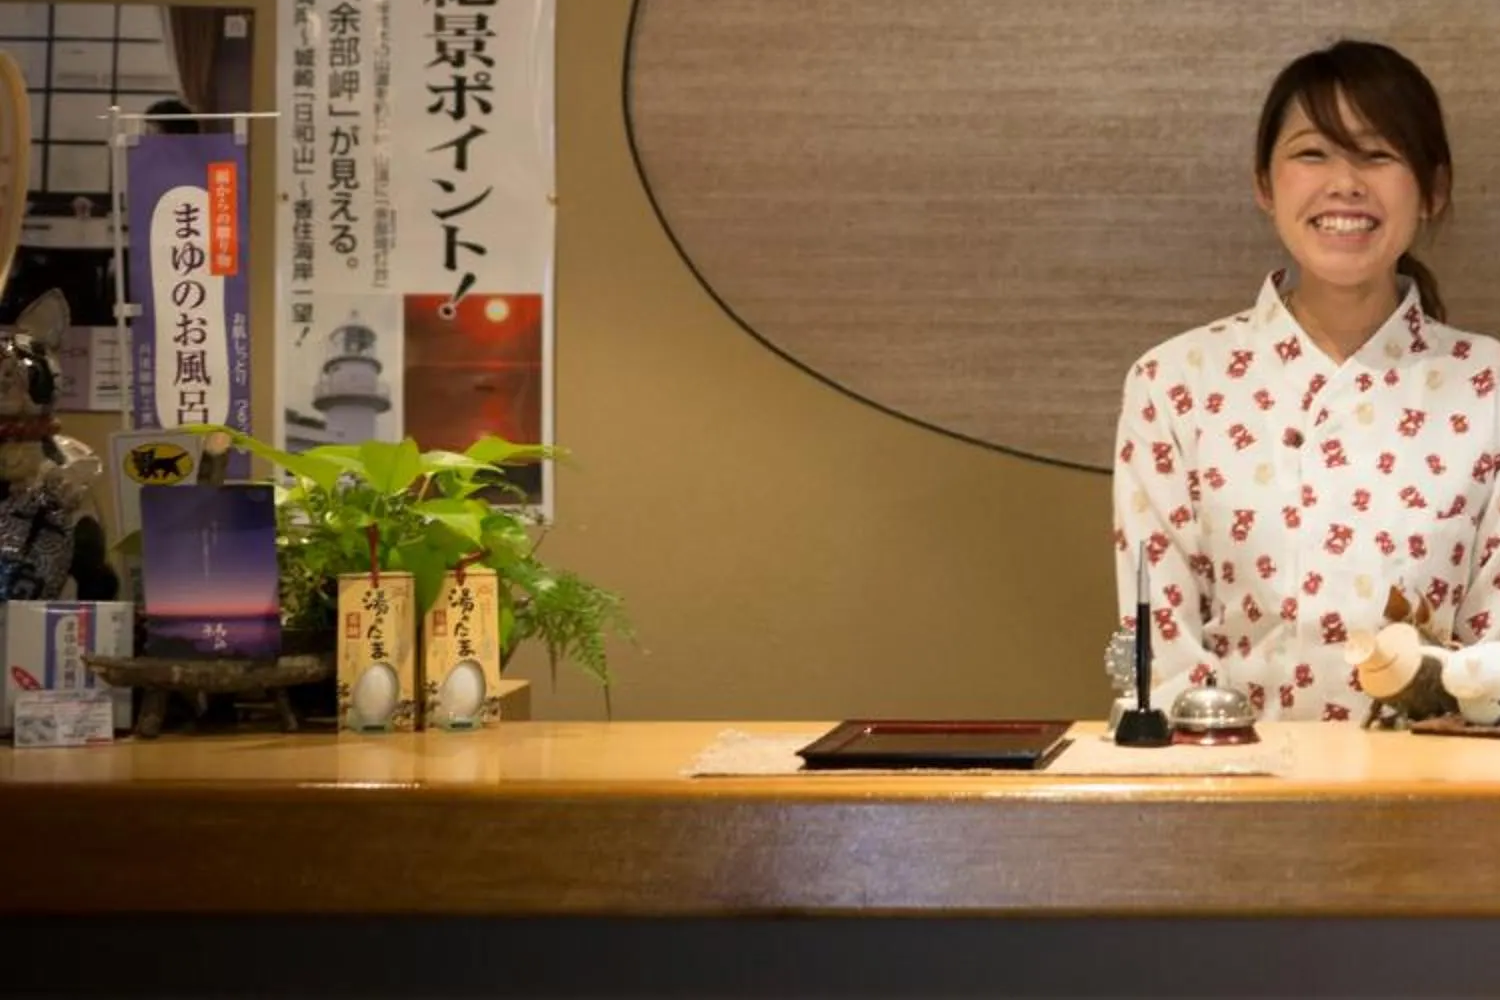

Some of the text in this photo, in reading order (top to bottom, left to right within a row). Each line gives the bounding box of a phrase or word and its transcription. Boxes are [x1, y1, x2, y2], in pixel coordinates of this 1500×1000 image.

[171, 202, 211, 425] まゆのお風呂
